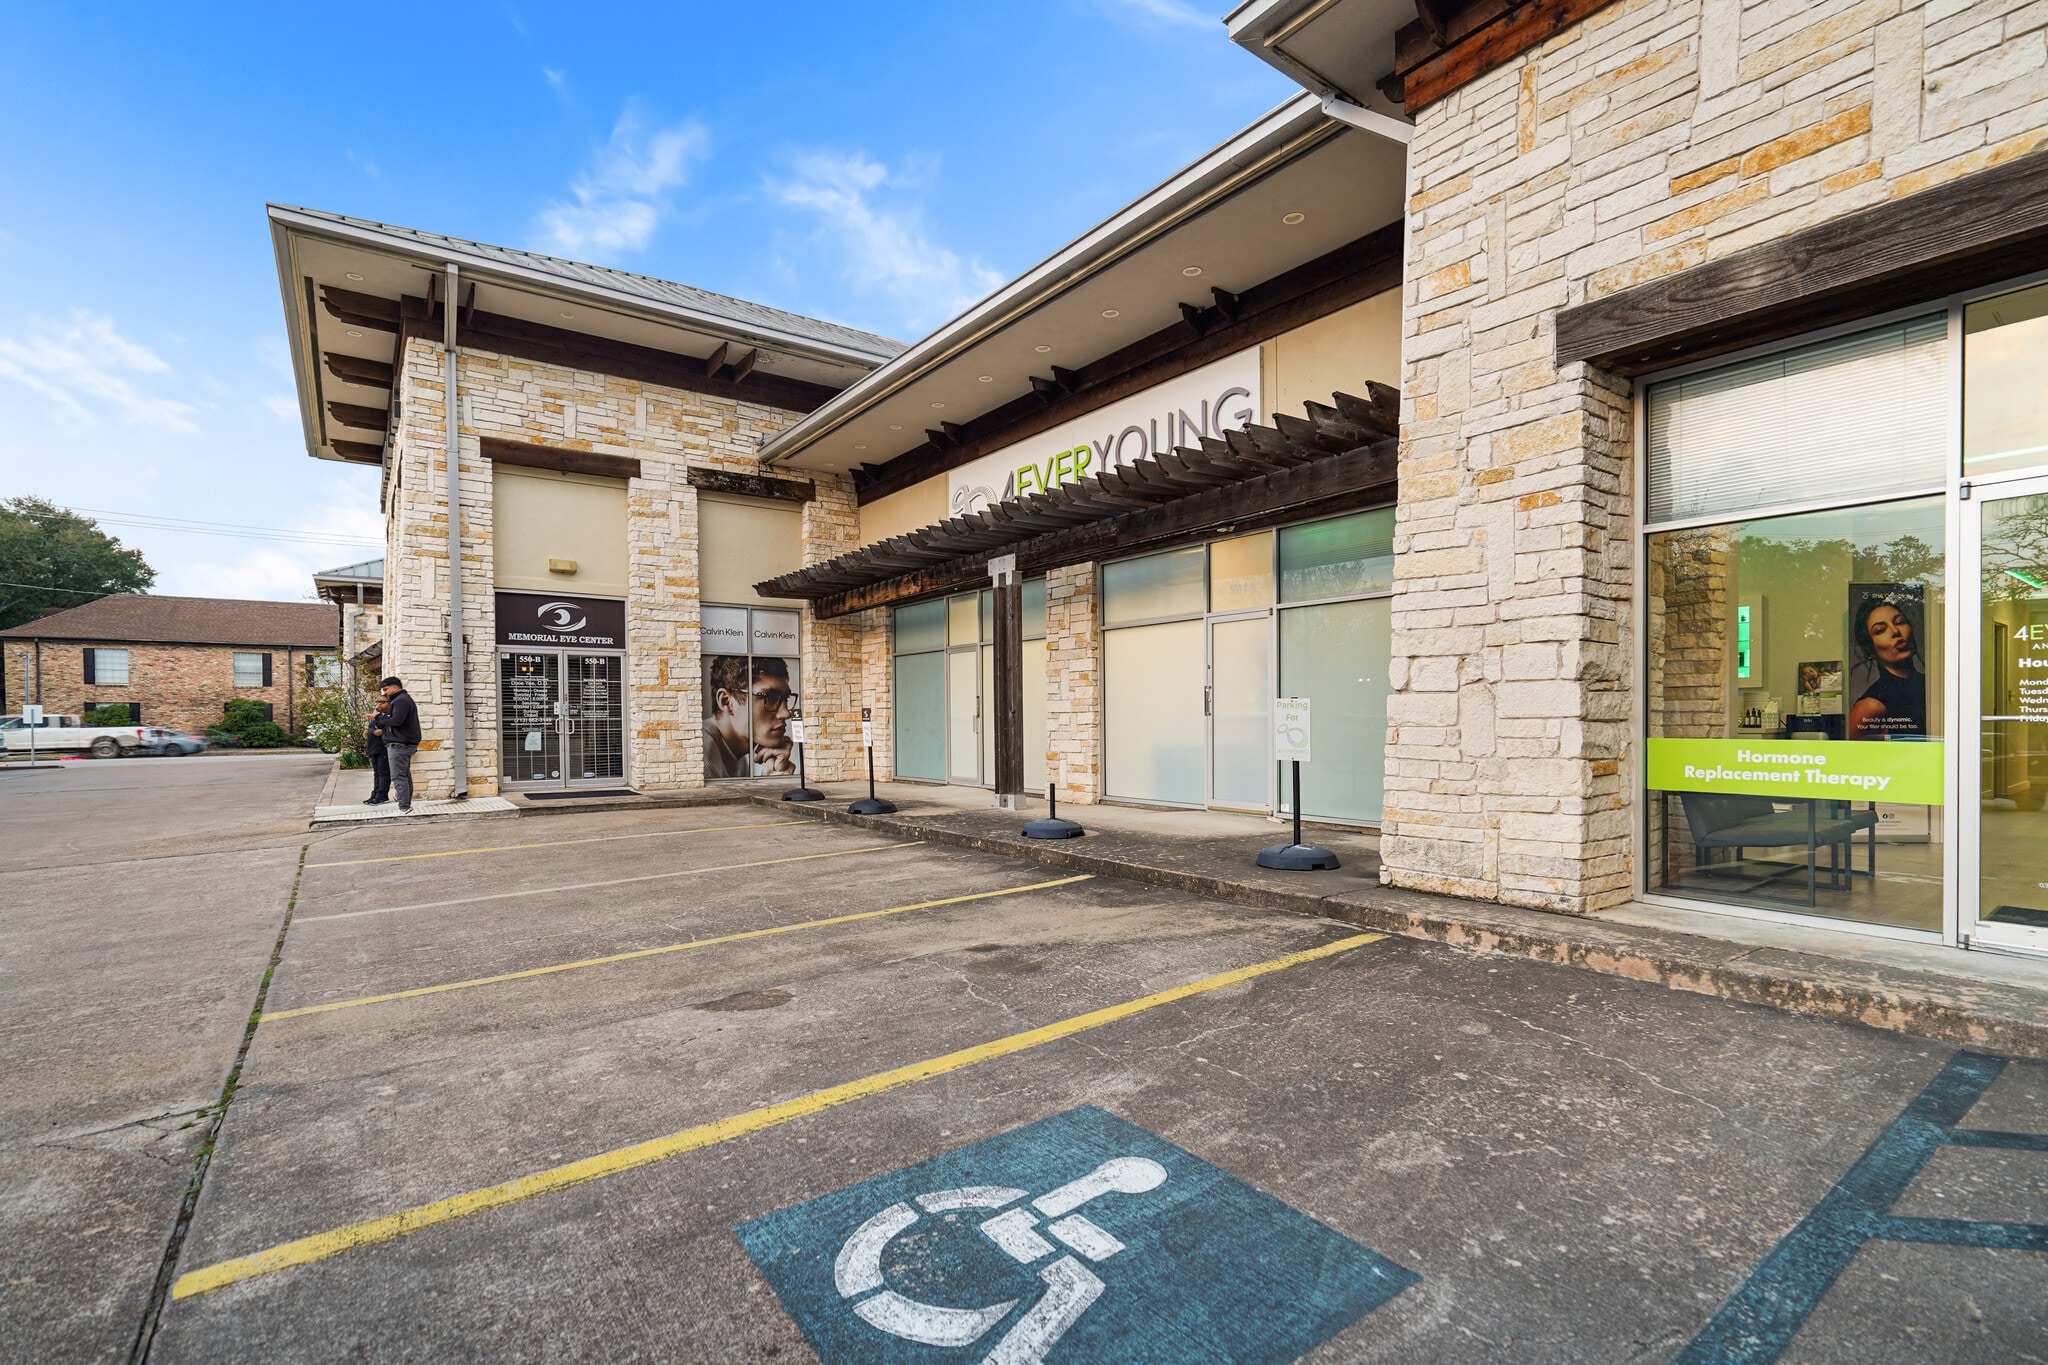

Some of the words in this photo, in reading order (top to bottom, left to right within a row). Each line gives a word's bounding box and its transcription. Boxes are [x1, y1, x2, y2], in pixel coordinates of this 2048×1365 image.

[700, 627, 724, 636] Calvin
[726, 628, 744, 636] Klein
[754, 630, 778, 639] Calvin
[778, 632, 796, 640] Klein
[508, 632, 558, 642] MEMORIAL
[579, 636, 614, 644] CENTER
[1276, 702, 1308, 710] Parking
[1737, 749, 1826, 765] Hormone
[1684, 765, 1800, 782] Replacement
[1805, 769, 1891, 790] Therapy
